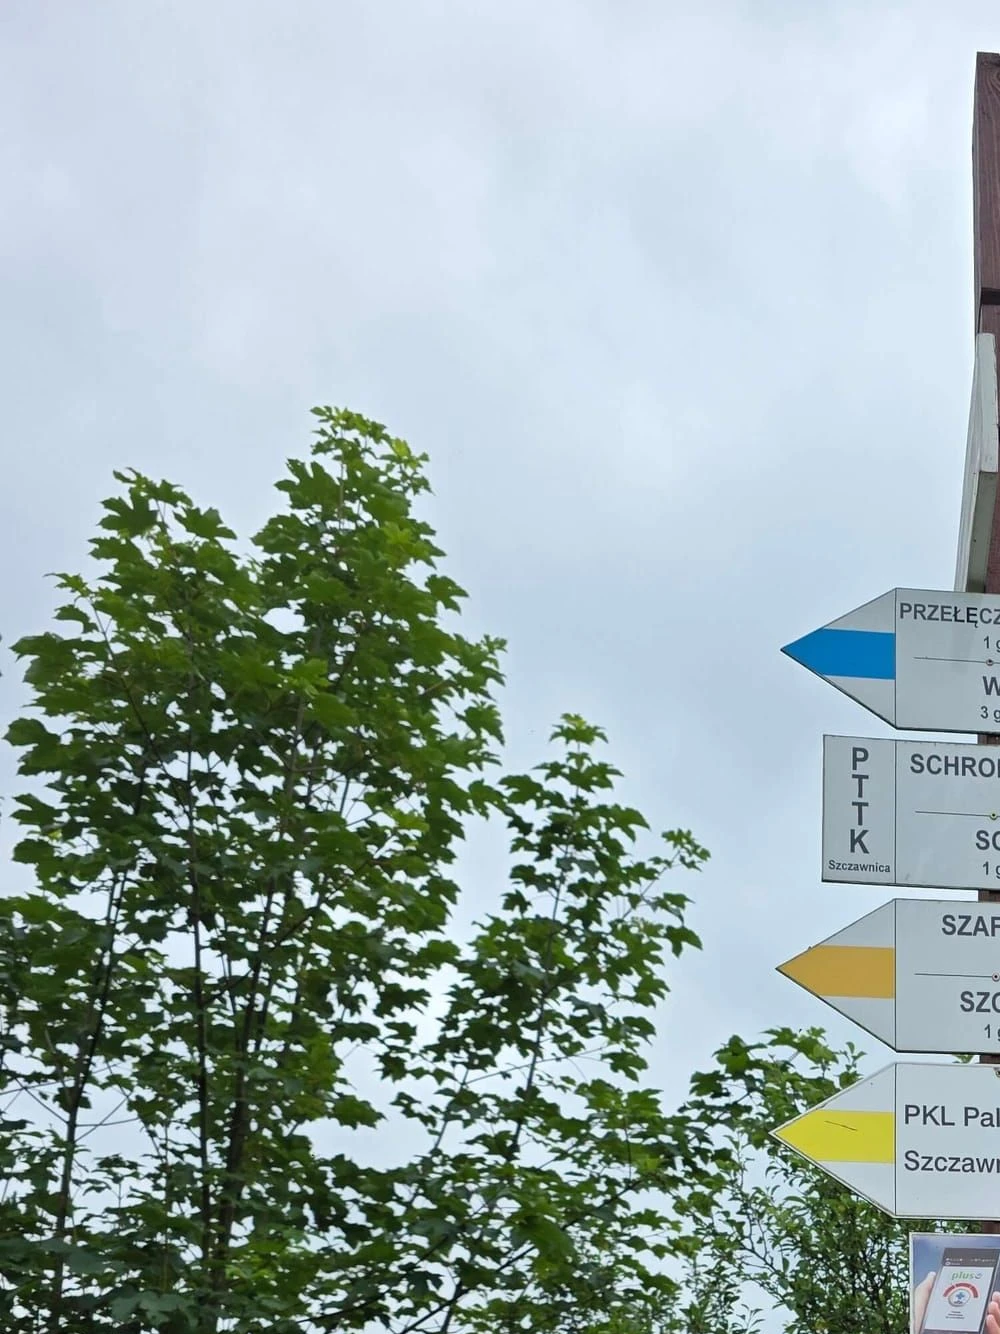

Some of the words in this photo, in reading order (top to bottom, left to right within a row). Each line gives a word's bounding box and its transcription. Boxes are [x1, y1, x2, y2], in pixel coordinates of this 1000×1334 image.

[983, 636, 990, 649] 1
[980, 705, 989, 719] 3
[828, 859, 891, 873] Szczawnica
[981, 861, 989, 876] 1
[983, 1024, 991, 1039] 1
[904, 1104, 955, 1127] PKL
